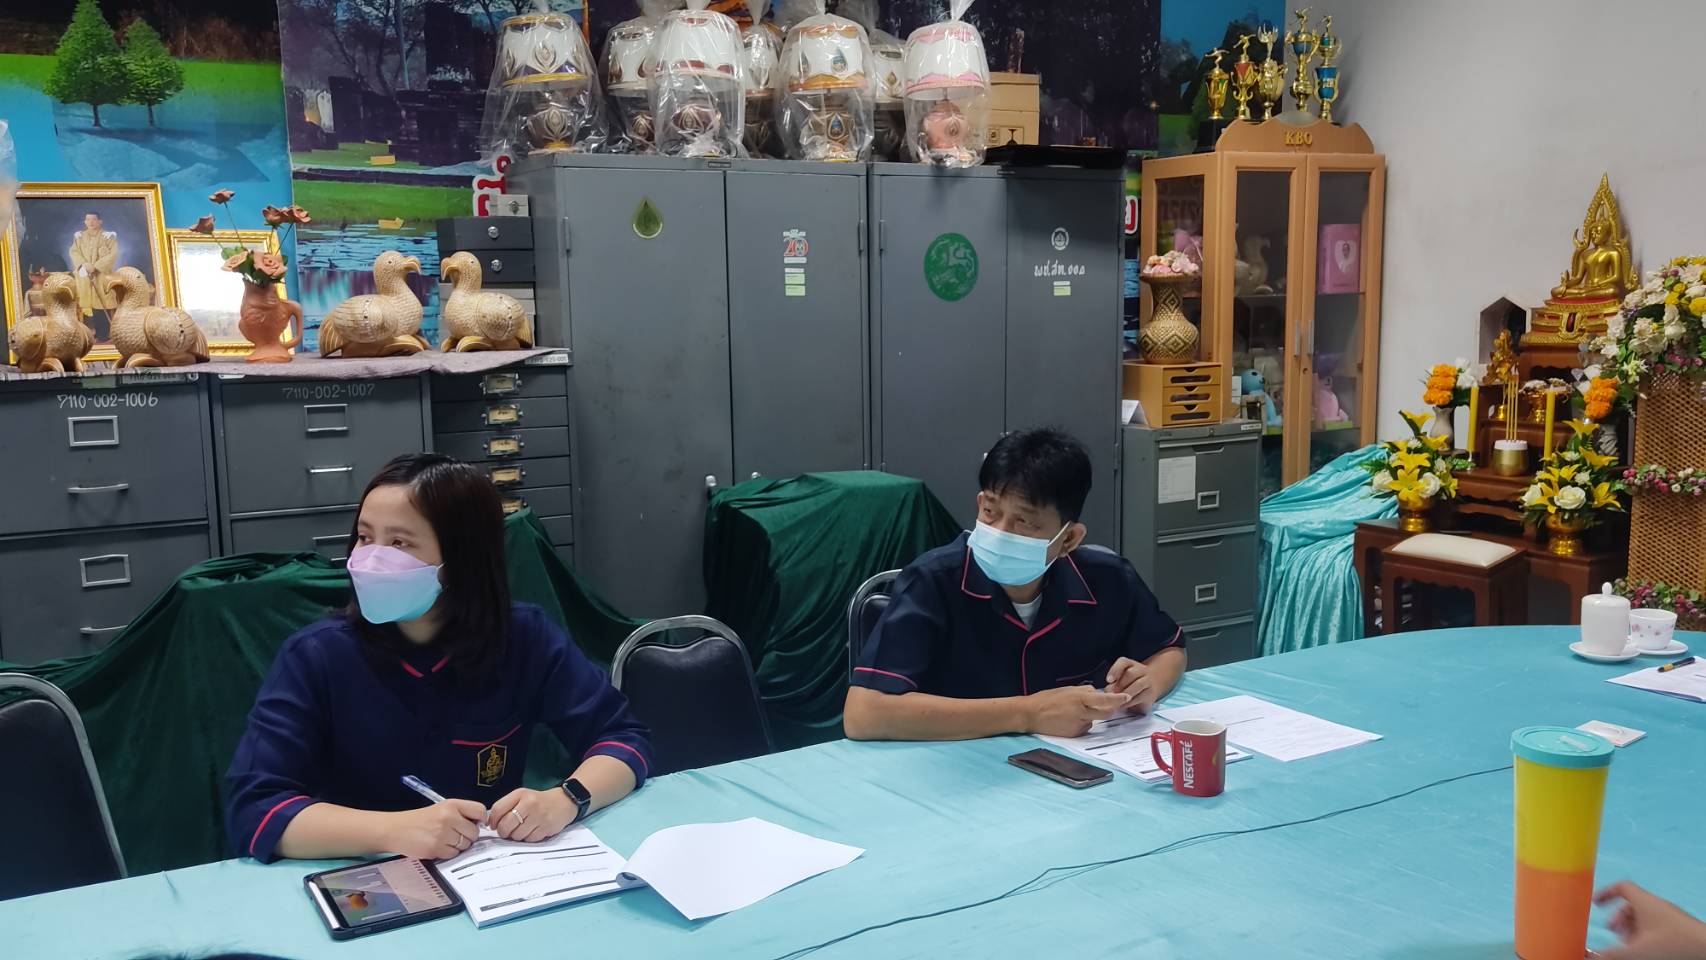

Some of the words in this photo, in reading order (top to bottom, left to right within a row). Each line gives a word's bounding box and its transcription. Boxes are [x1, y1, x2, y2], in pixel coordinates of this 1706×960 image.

[1284, 131, 1313, 145] KBO
[282, 383, 375, 400] 7110-002-1007
[56, 392, 159, 409] 7110-002-1006
[1179, 739, 1195, 789] NESCAFÉ
